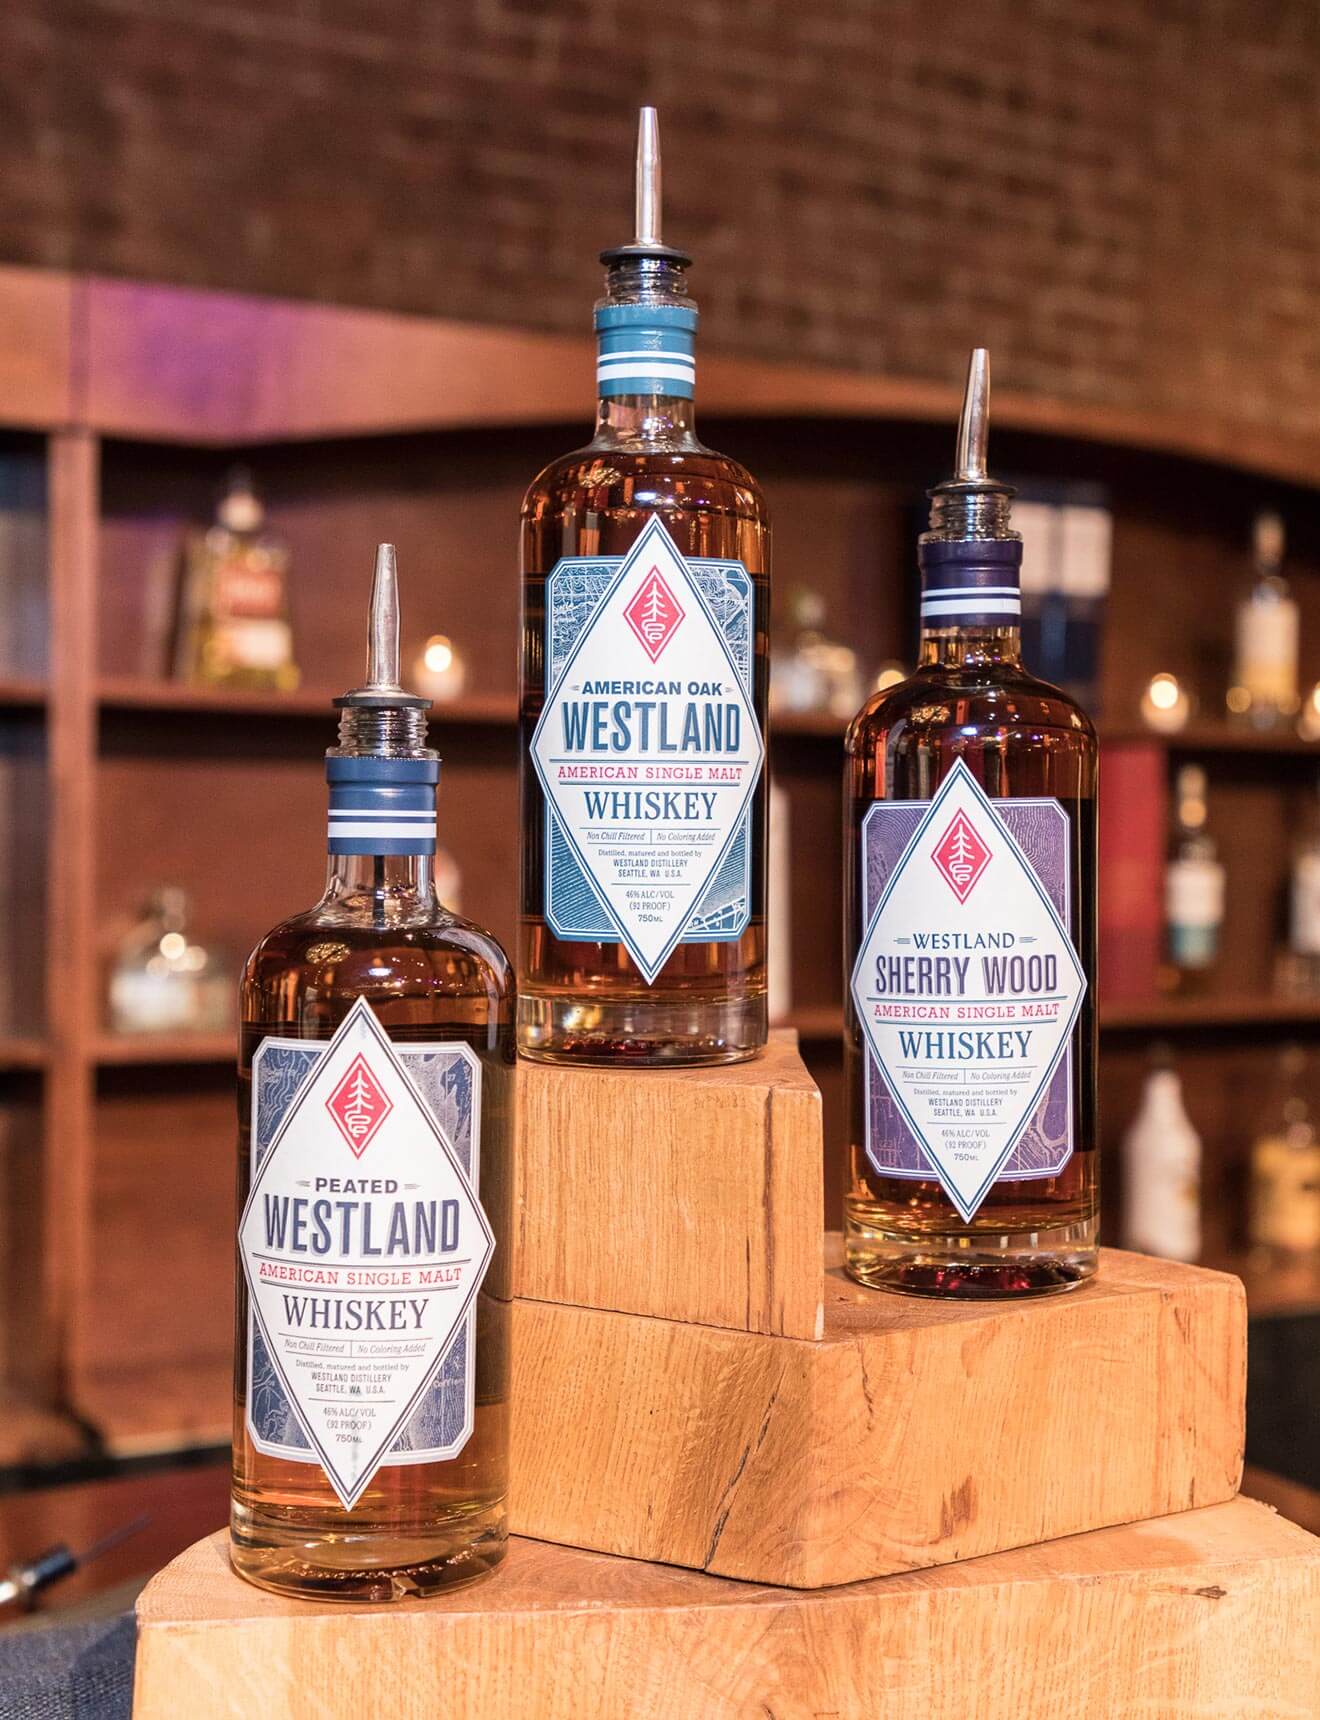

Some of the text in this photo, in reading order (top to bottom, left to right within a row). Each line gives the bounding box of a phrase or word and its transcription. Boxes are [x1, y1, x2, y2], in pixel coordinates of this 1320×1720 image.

[581, 681, 722, 696] AMERICAN OAK
[561, 700, 740, 754] WESTLAND
[558, 766, 742, 780] AMERICAN SINGLE MALT
[584, 791, 718, 820] WHISKEY
[586, 832, 646, 840] Non Chill Filtered
[668, 833, 696, 842] Coloring
[614, 859, 688, 868] WESTLAND DISTILLERY
[913, 933, 1014, 949] WESTLAND
[876, 954, 1057, 996] SHERRY WOOD
[874, 1003, 1060, 1018] AMERICAN SINGLE MALT
[898, 1030, 1032, 1060] WHISKEY
[916, 1071, 931, 1079] Chill
[932, 1072, 958, 1080] Filtered
[982, 1071, 1010, 1081] Coloring
[1011, 1070, 1031, 1079] Added
[1009, 1088, 1017, 1096] by
[315, 1178, 398, 1194] PEATED
[264, 1193, 460, 1257] WESTLAND
[259, 1263, 462, 1285] AMERICAN SINGLE MALT
[282, 1294, 429, 1330] WHISKEY
[284, 1339, 345, 1353] Non Chill Filtered
[358, 1344, 426, 1354] No Coloring Added
[400, 1362, 409, 1371] by
[312, 1372, 392, 1382] WESTLAND DISTILLERY
[350, 1386, 361, 1394] WA
